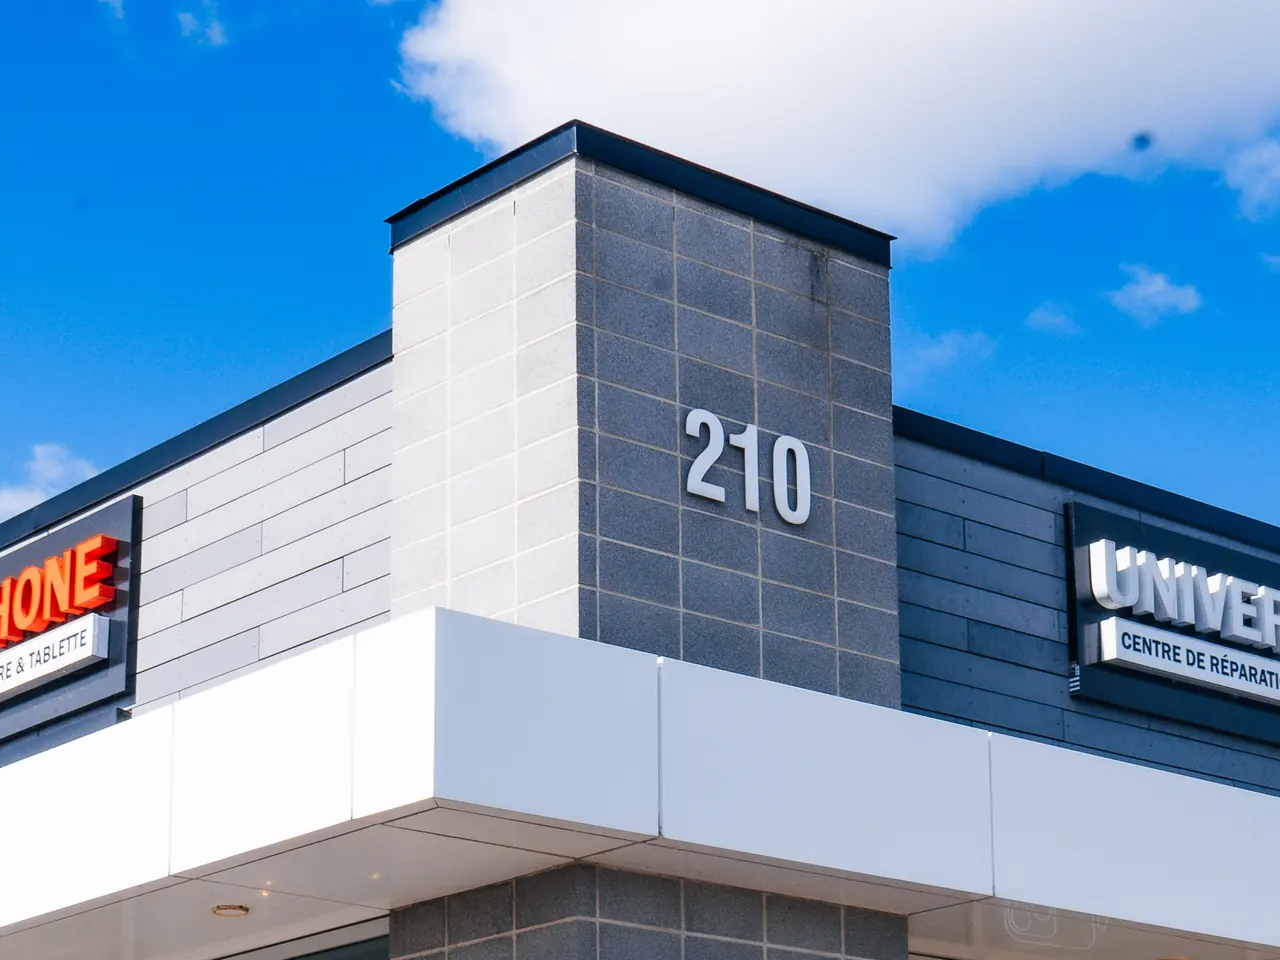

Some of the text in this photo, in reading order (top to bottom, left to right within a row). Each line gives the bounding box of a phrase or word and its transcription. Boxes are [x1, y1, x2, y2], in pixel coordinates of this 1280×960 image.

[686, 409, 811, 524] 210
[16, 657, 25, 676] &
[29, 628, 88, 669] TABLETTE
[1122, 632, 1181, 664] CENTRE
[1186, 649, 1205, 669] DE
